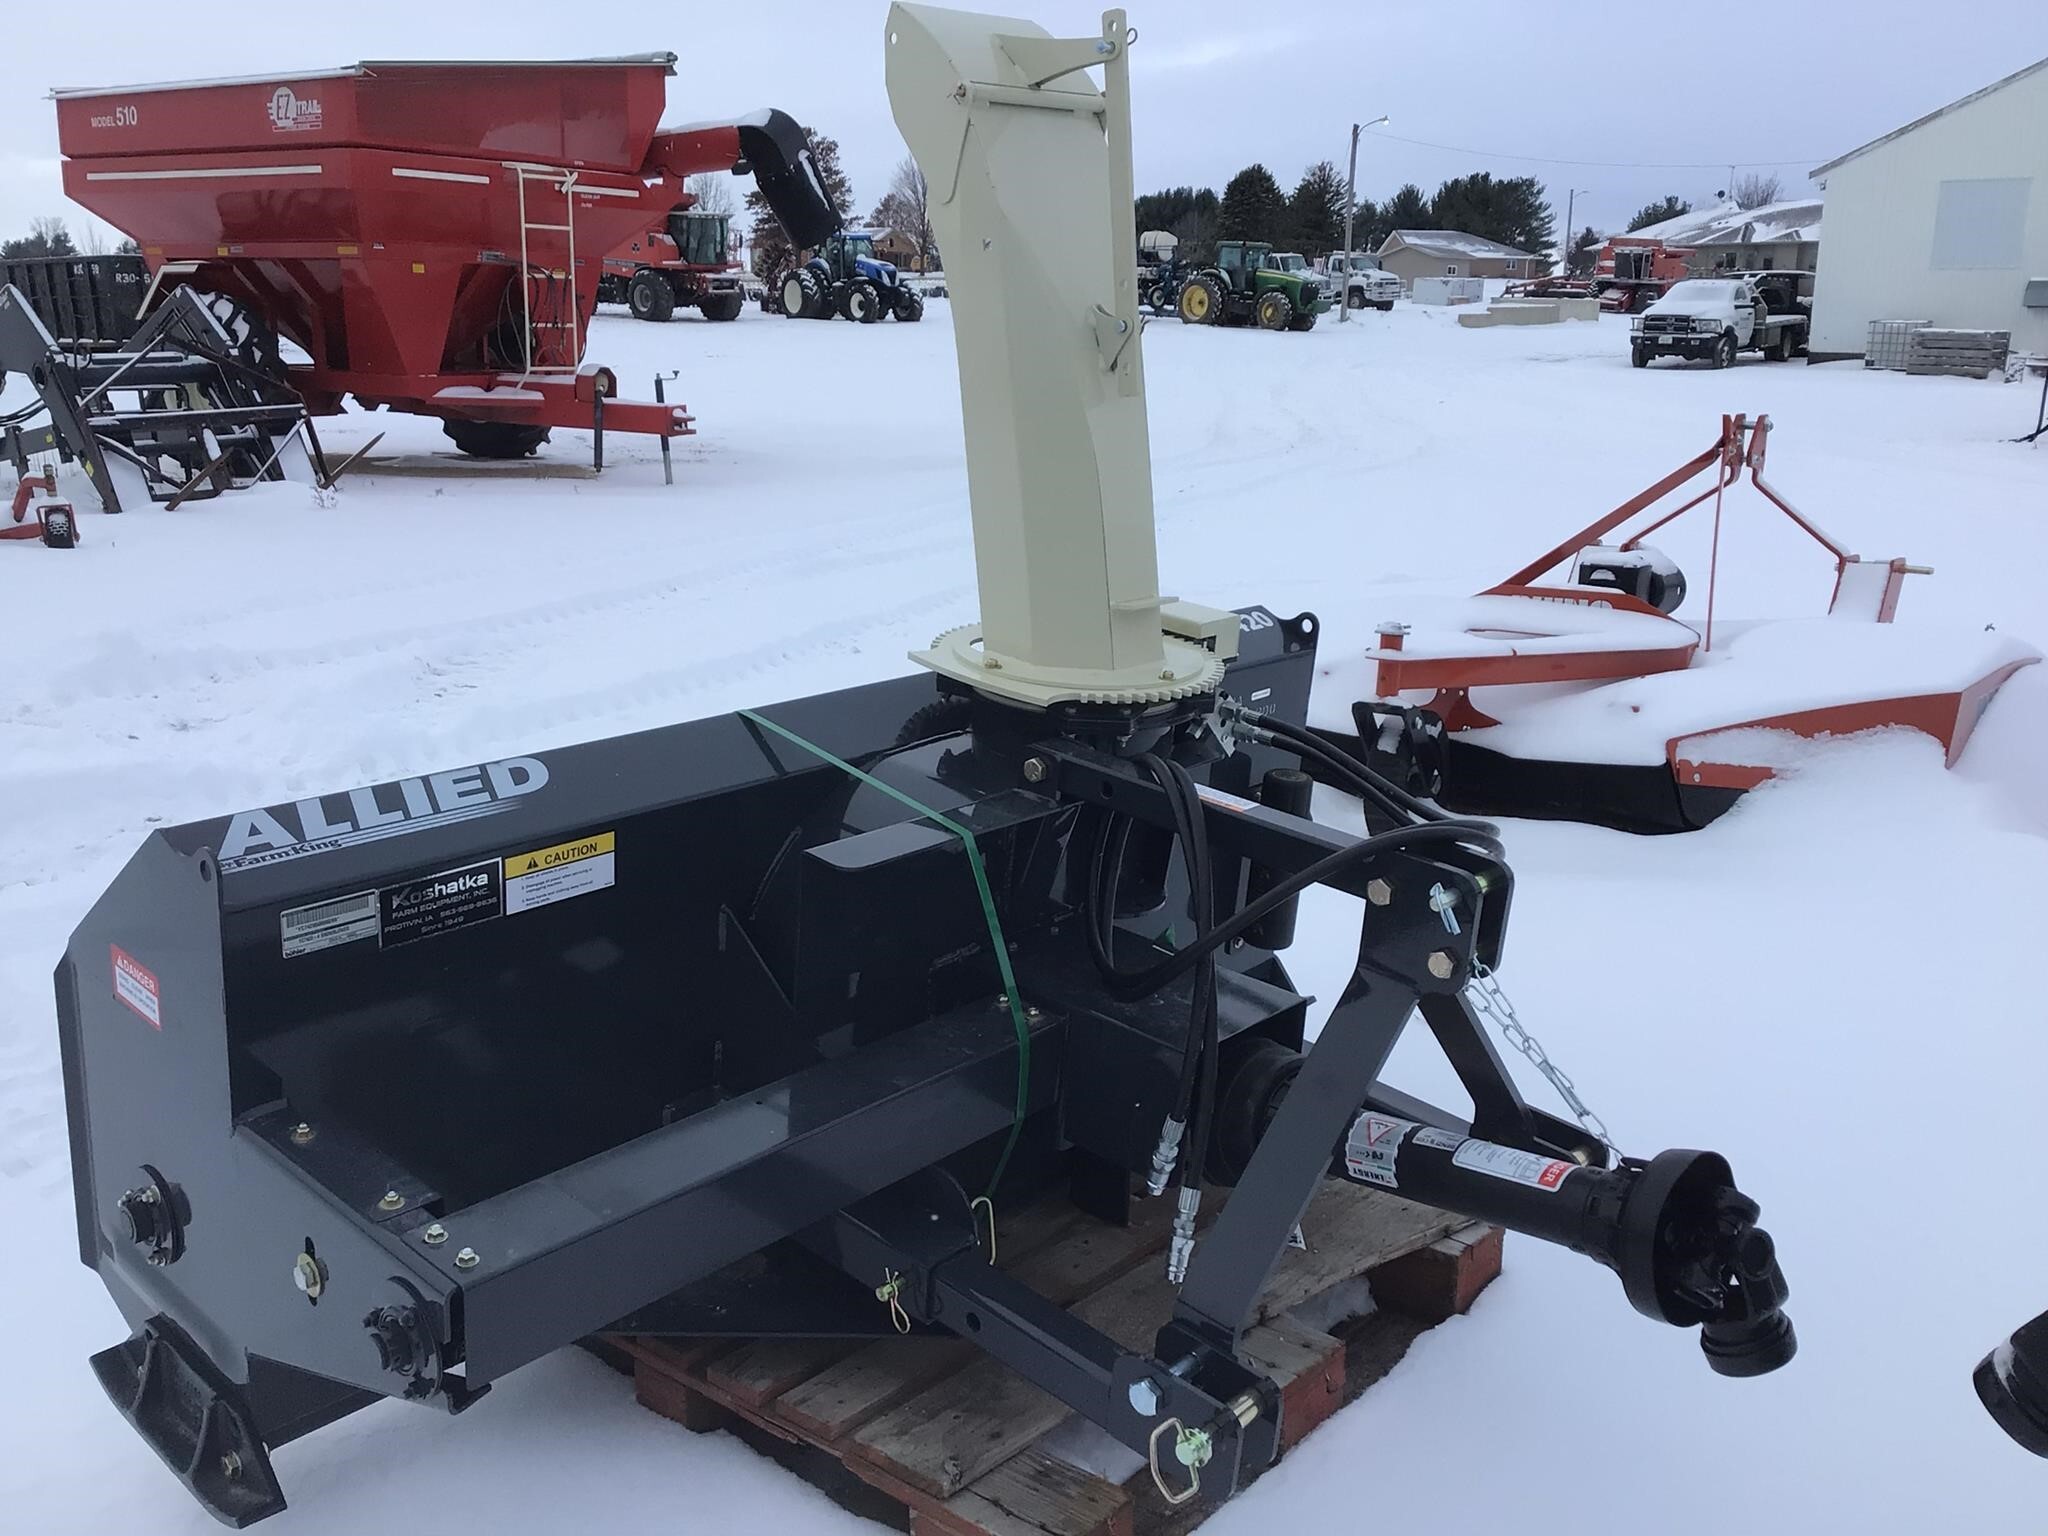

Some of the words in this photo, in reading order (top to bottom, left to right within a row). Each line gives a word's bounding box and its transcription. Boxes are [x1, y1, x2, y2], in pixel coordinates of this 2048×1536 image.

[91, 115, 115, 127] MODEL
[116, 105, 137, 125] 510
[1240, 611, 1274, 632] 20
[217, 757, 549, 860] ALLIED
[544, 842, 598, 865] CAUTION
[392, 873, 488, 909] Koshatka
[392, 906, 418, 919] FARM
[124, 959, 155, 993] DANGER
